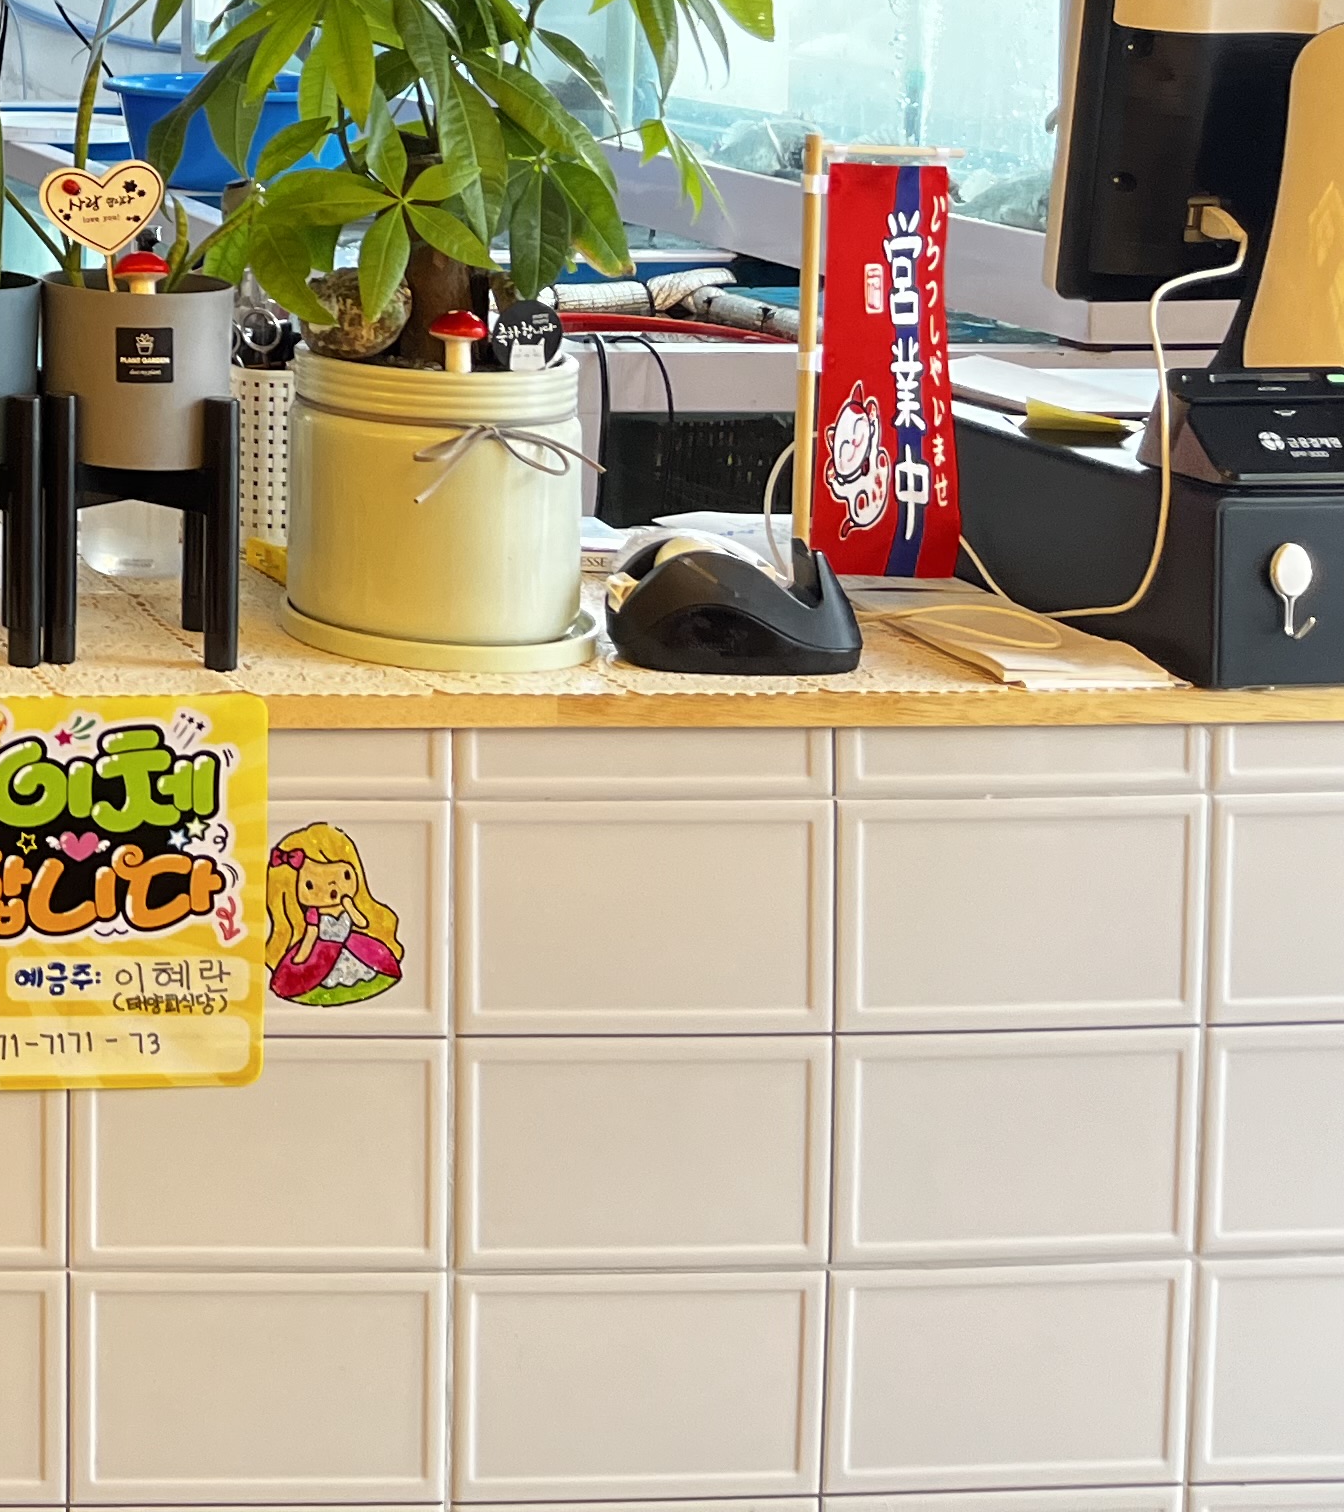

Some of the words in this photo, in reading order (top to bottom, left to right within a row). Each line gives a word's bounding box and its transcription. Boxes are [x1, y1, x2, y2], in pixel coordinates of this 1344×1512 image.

[883, 209, 930, 541] 営業中
[14, 962, 102, 996] 예금주:
